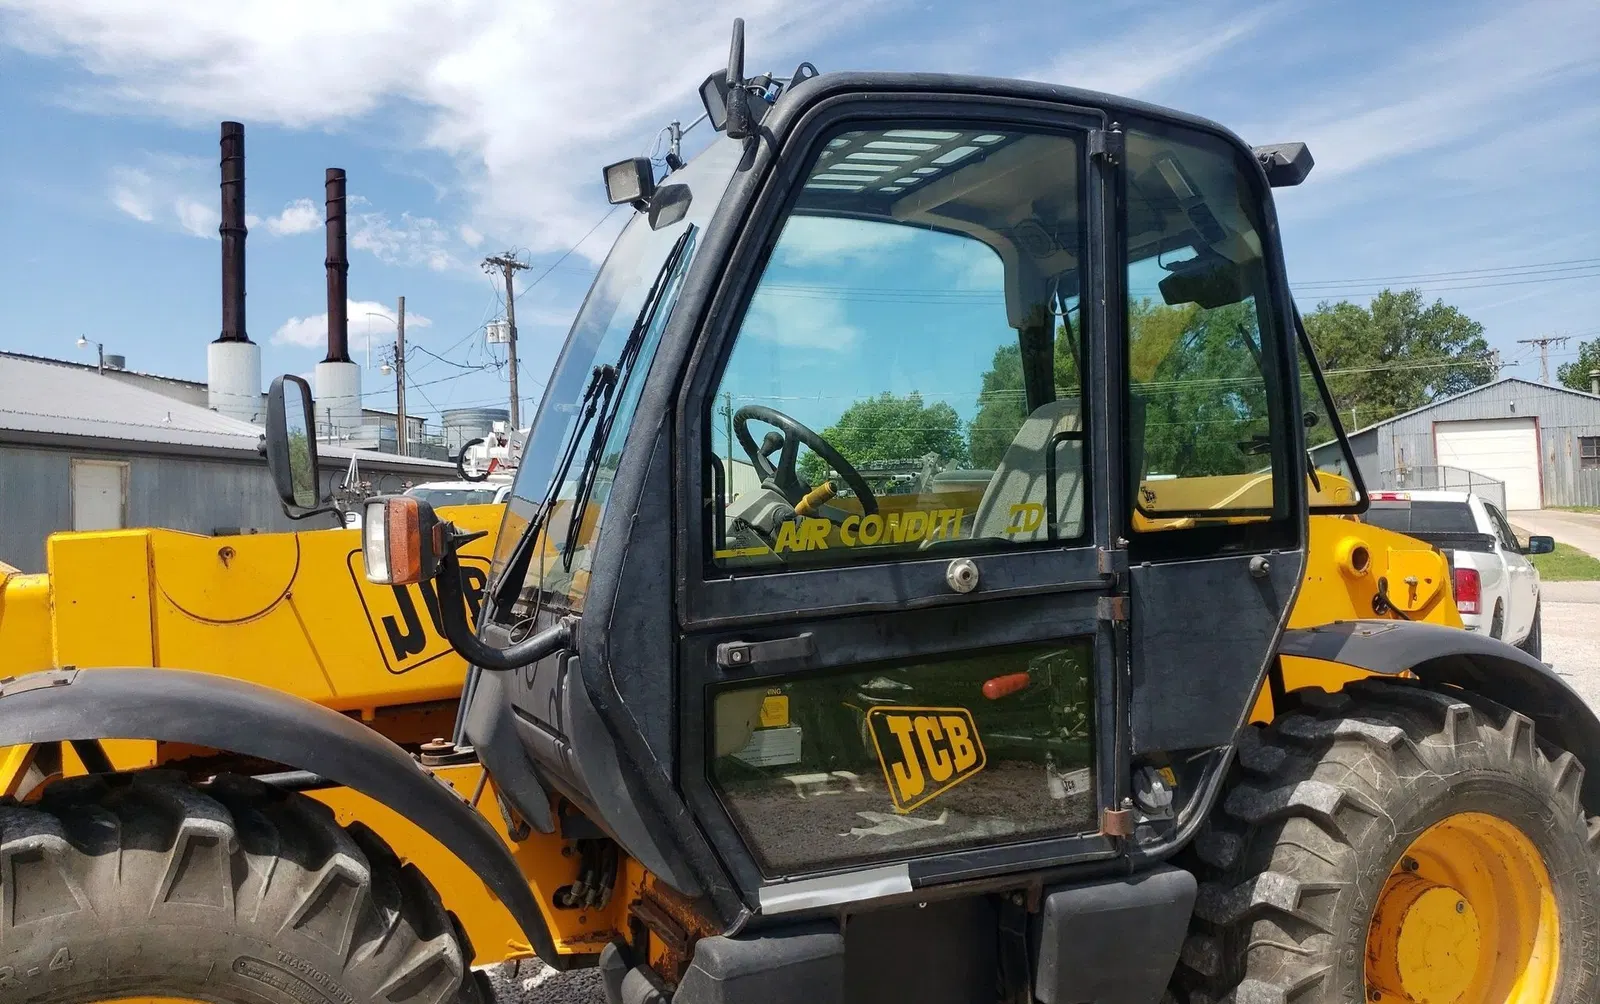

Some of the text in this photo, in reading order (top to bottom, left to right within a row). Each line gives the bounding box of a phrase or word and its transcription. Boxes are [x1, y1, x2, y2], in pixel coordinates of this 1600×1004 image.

[774, 516, 832, 553] AIR
[886, 715, 977, 803] JCB
[276, 949, 330, 987] TRACTION
